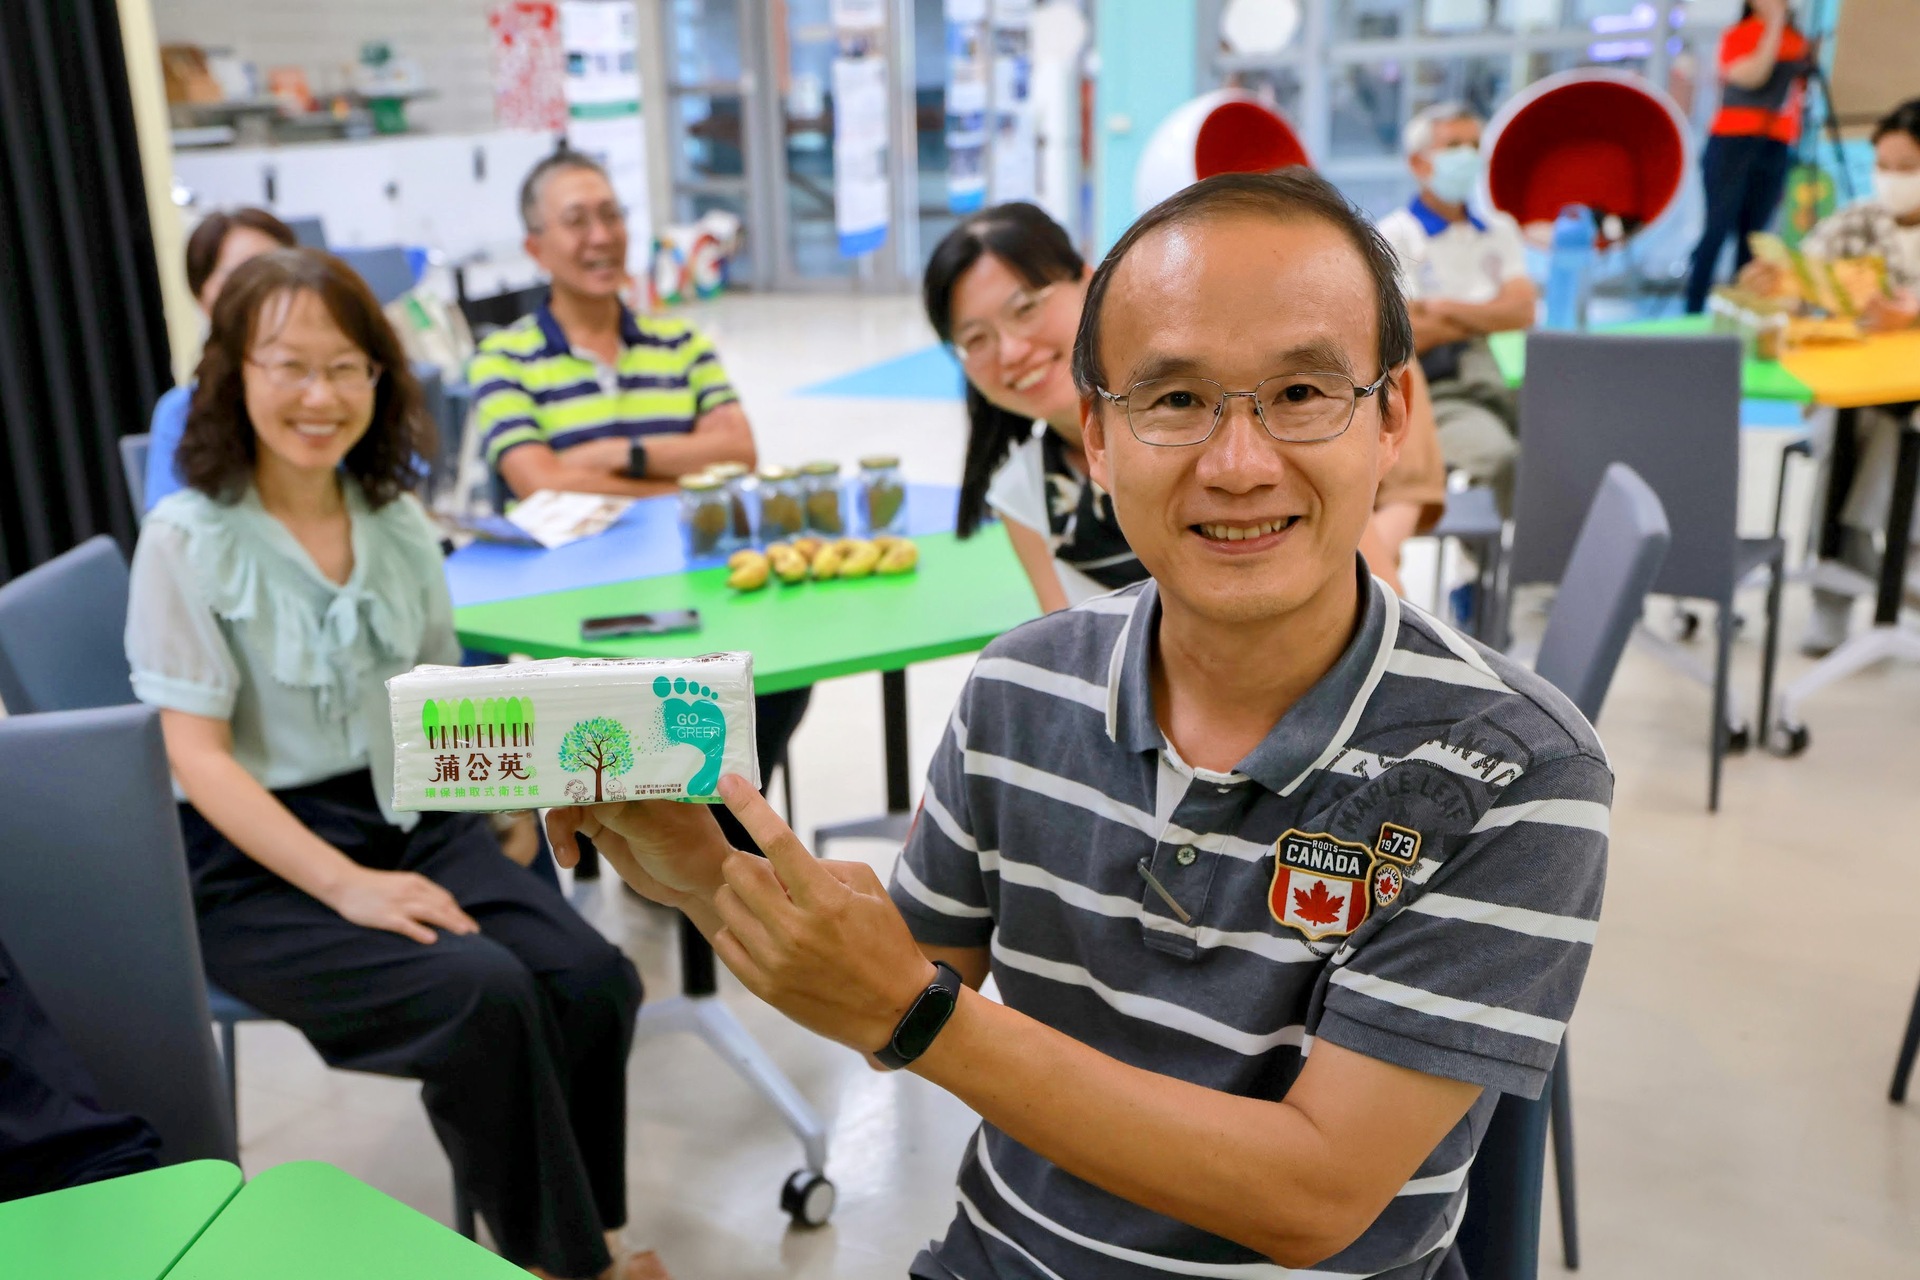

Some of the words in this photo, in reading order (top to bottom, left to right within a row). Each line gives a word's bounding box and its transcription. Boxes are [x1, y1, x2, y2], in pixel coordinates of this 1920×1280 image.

[677, 713, 699, 725] GO
[677, 726, 720, 739] GREEN
[428, 753, 532, 782] 蒲公英
[425, 785, 539, 798] 環保抽取式衛生紙
[1312, 840, 1339, 853] ROOTS
[1286, 844, 1360, 875] CANADA
